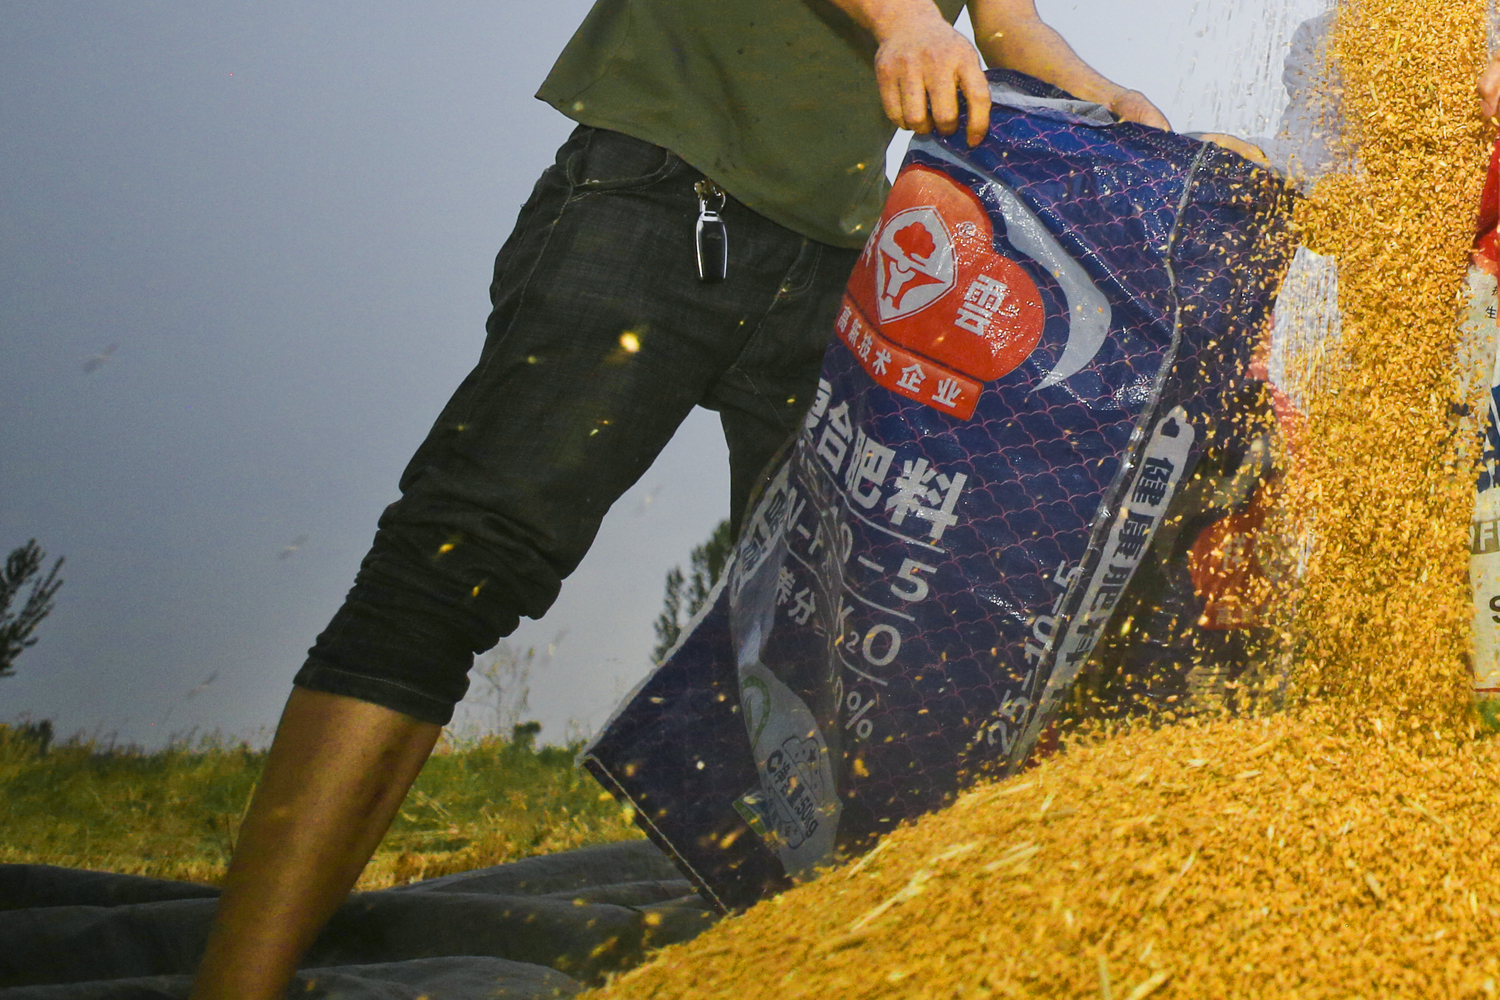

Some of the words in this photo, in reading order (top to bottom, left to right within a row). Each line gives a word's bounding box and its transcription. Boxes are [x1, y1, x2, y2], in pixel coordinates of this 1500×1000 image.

[837, 305, 963, 409] 高新技术企业
